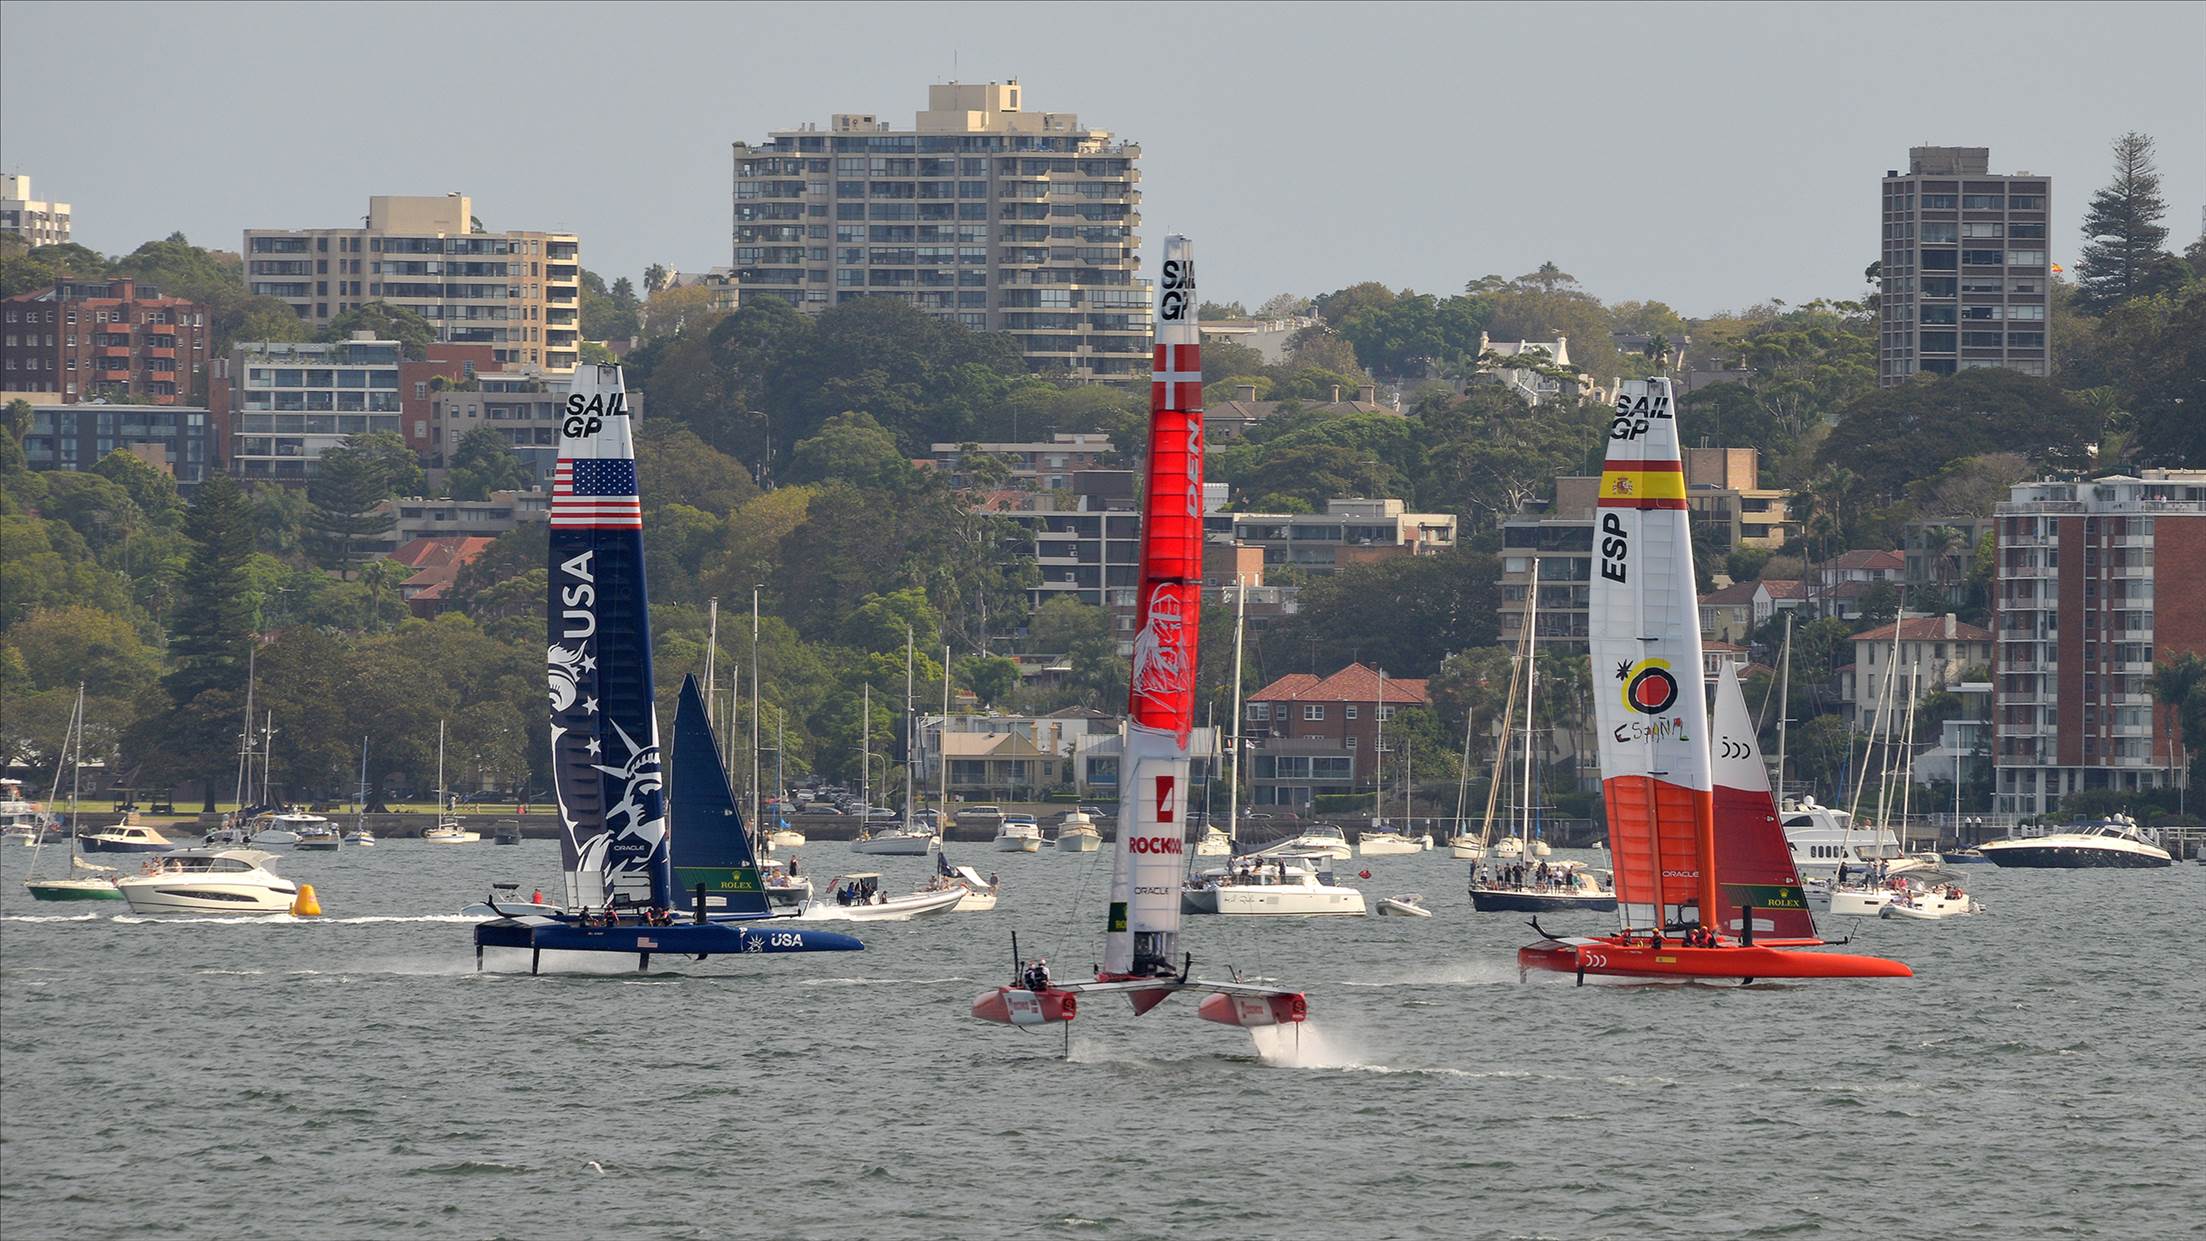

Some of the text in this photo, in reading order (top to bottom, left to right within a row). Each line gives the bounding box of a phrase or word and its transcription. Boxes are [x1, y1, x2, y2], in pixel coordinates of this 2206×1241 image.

[566, 393, 628, 416] SAIL
[1616, 395, 1673, 419] SAIL
[563, 417, 602, 438] GP
[1610, 418, 1649, 440] GP
[1187, 419, 1200, 519] DEN
[1602, 513, 1627, 584] ESP
[561, 550, 596, 638] USA
[721, 881, 752, 889] ROLEX
[1663, 870, 1699, 878] ORACLE
[1768, 899, 1799, 907] ROLEX
[771, 933, 803, 947] USA
